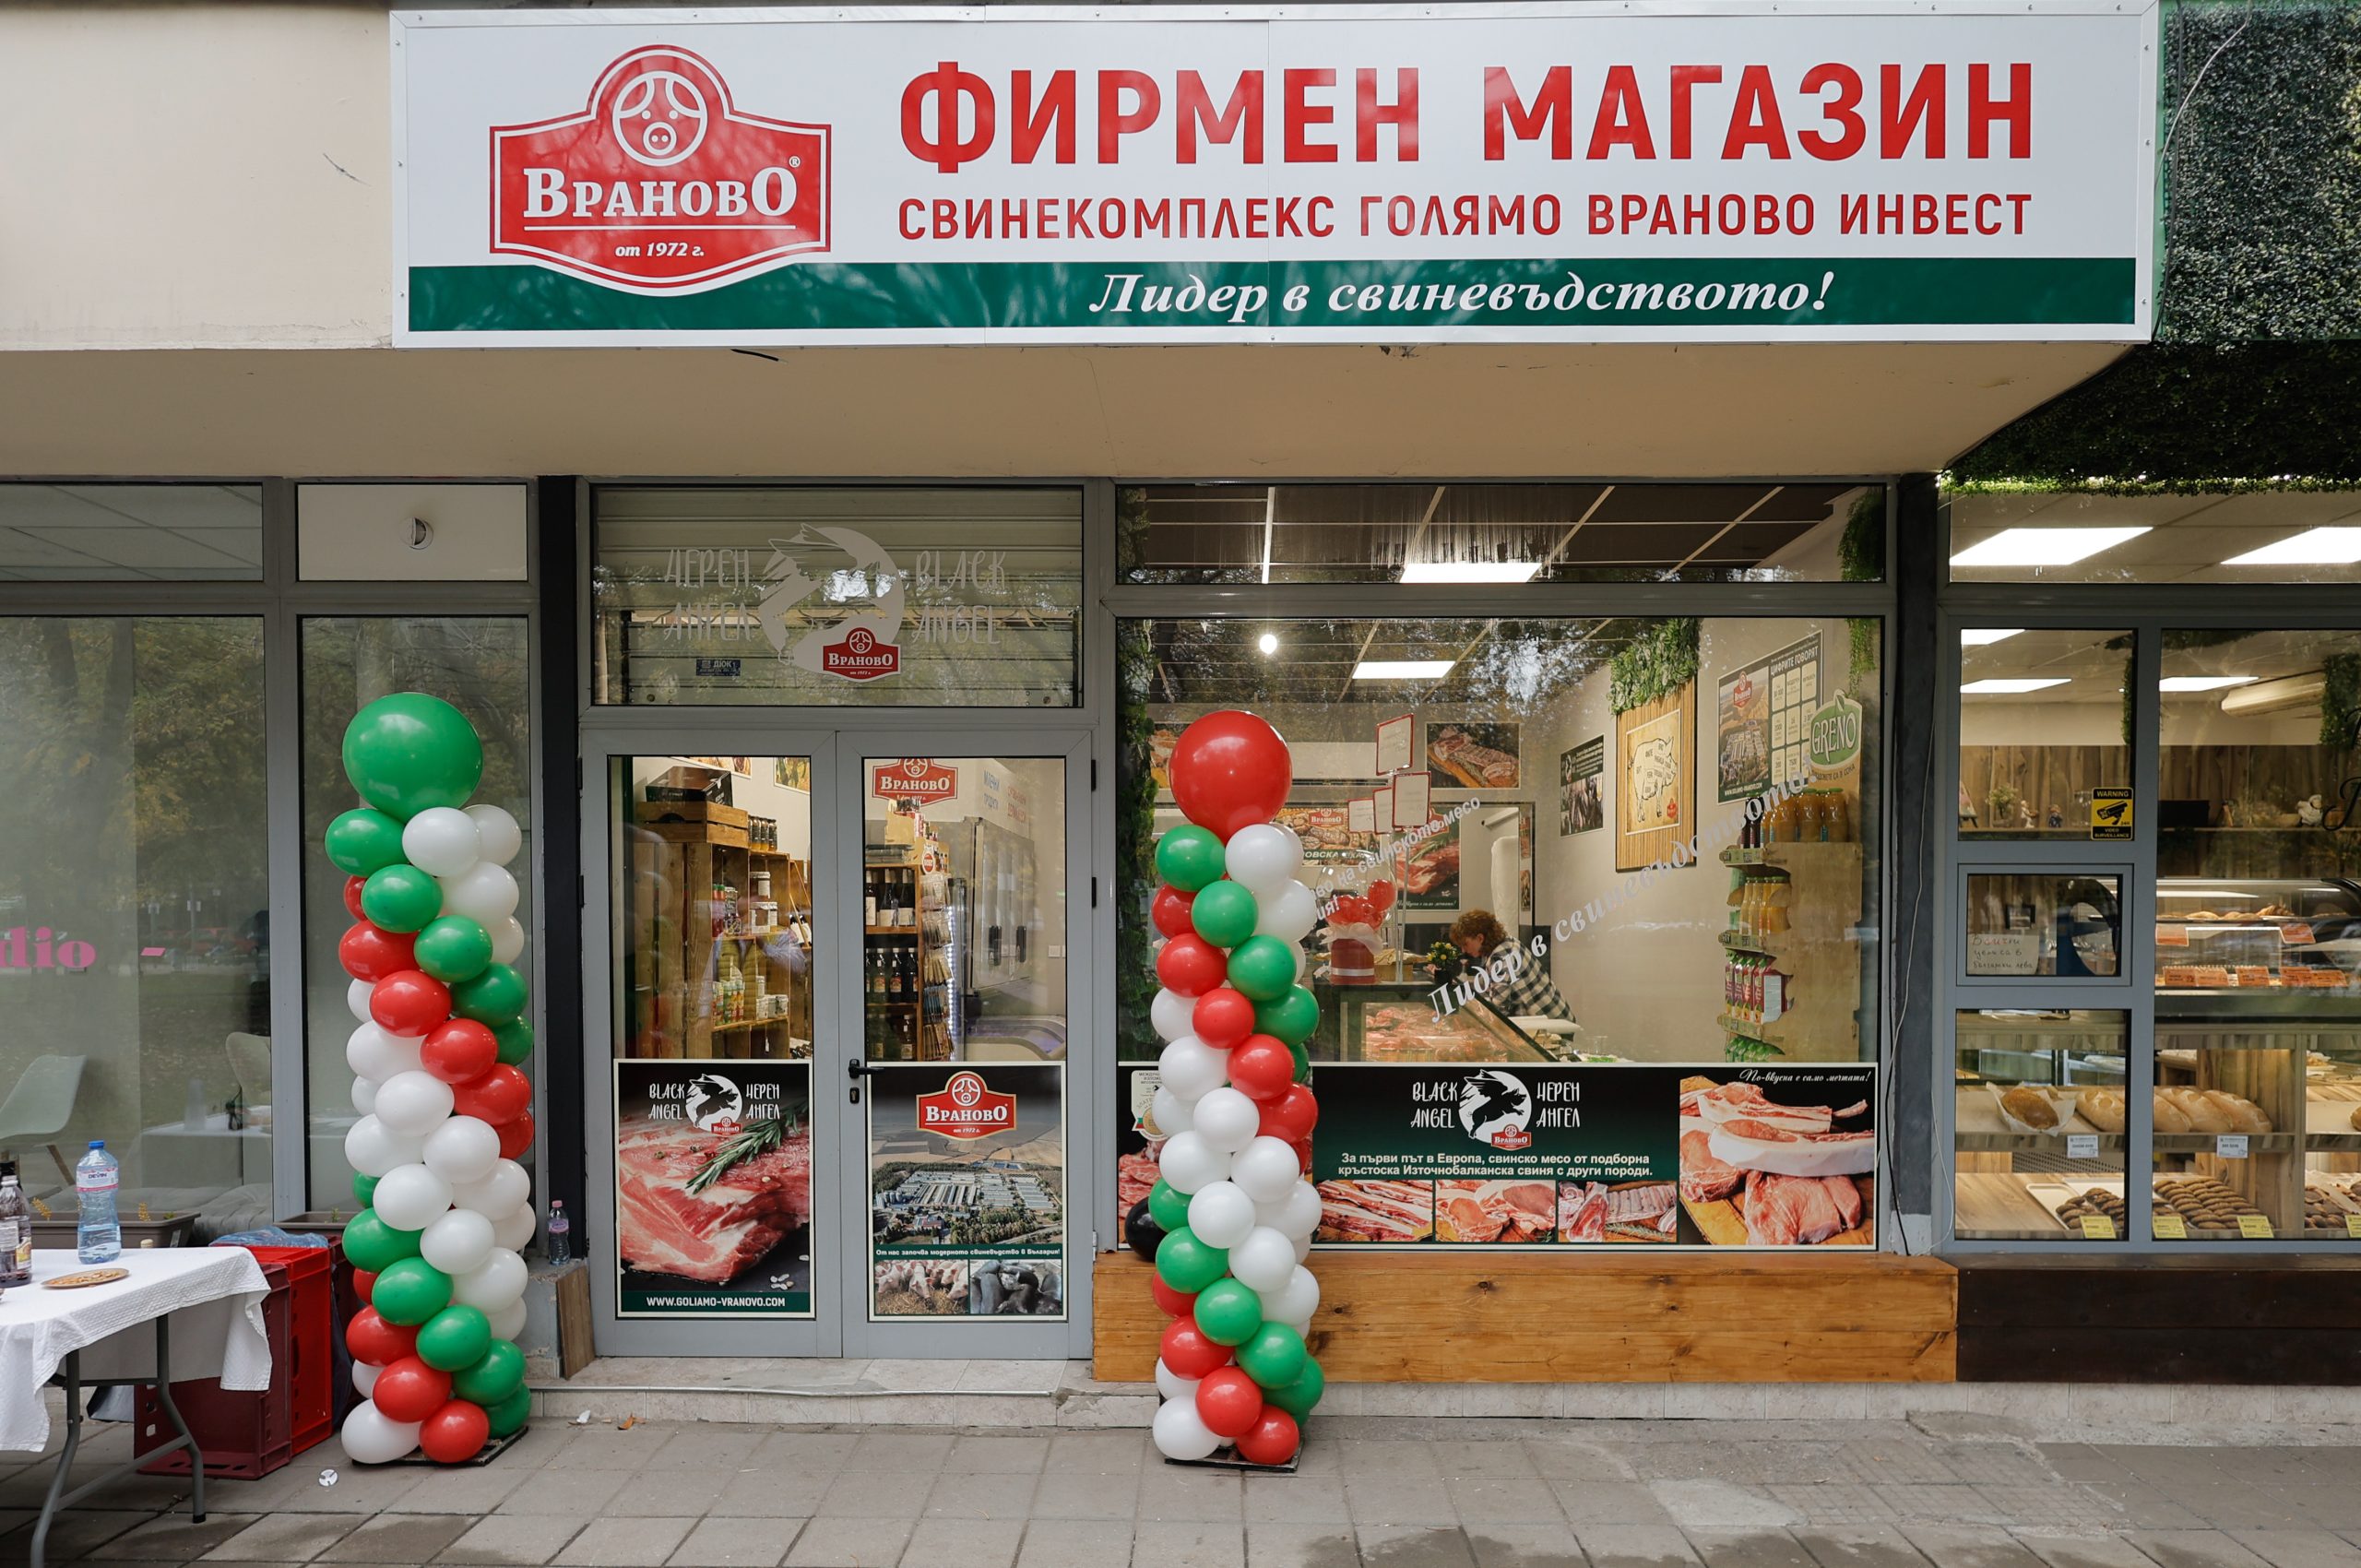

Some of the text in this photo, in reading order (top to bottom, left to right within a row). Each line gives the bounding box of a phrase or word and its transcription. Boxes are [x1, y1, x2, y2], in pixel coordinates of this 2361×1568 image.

[900, 61, 2034, 173] ФИРМЕН МАГАЗИН
[523, 167, 797, 218] ВРАНОВО
[898, 192, 2034, 240] СВИНЕКОМПЛЕКС ГОЛЯМО ВРАНОВО ИНВЕСТ
[615, 245, 640, 257] от
[647, 243, 687, 257] 1972
[1088, 271, 1835, 324] Лидер в свиневъдството!
[916, 551, 1006, 590] BLACK
[911, 604, 1001, 645] ANGEL
[1811, 711, 1857, 763] GRENO
[1442, 797, 1481, 826] месо
[1427, 950, 1523, 1023] Лидер
[1531, 934, 1548, 957] в
[1738, 1068, 1792, 1085] По-вкусна
[649, 1083, 685, 1099] BLACK
[745, 1083, 780, 1099] ЧЕРЕН
[1412, 1081, 1458, 1101] BLACK
[1536, 1081, 1580, 1102] ЧЕРЕН
[647, 1104, 682, 1120] ANGEL
[745, 1104, 780, 1120] АНГЕЛ
[925, 1105, 1007, 1122] ВРАНОВО
[1410, 1108, 1455, 1128] ANGEL
[1536, 1108, 1581, 1128] АНГЕЛ
[1341, 1153, 1650, 1166] За първи път в Европа, свинско месо от подборна
[1338, 1164, 1653, 1178] кръстоска Източнобалканска свиня с други породи.
[647, 1297, 786, 1307] WWW.GOLIAMO-VRANOVO.COM
